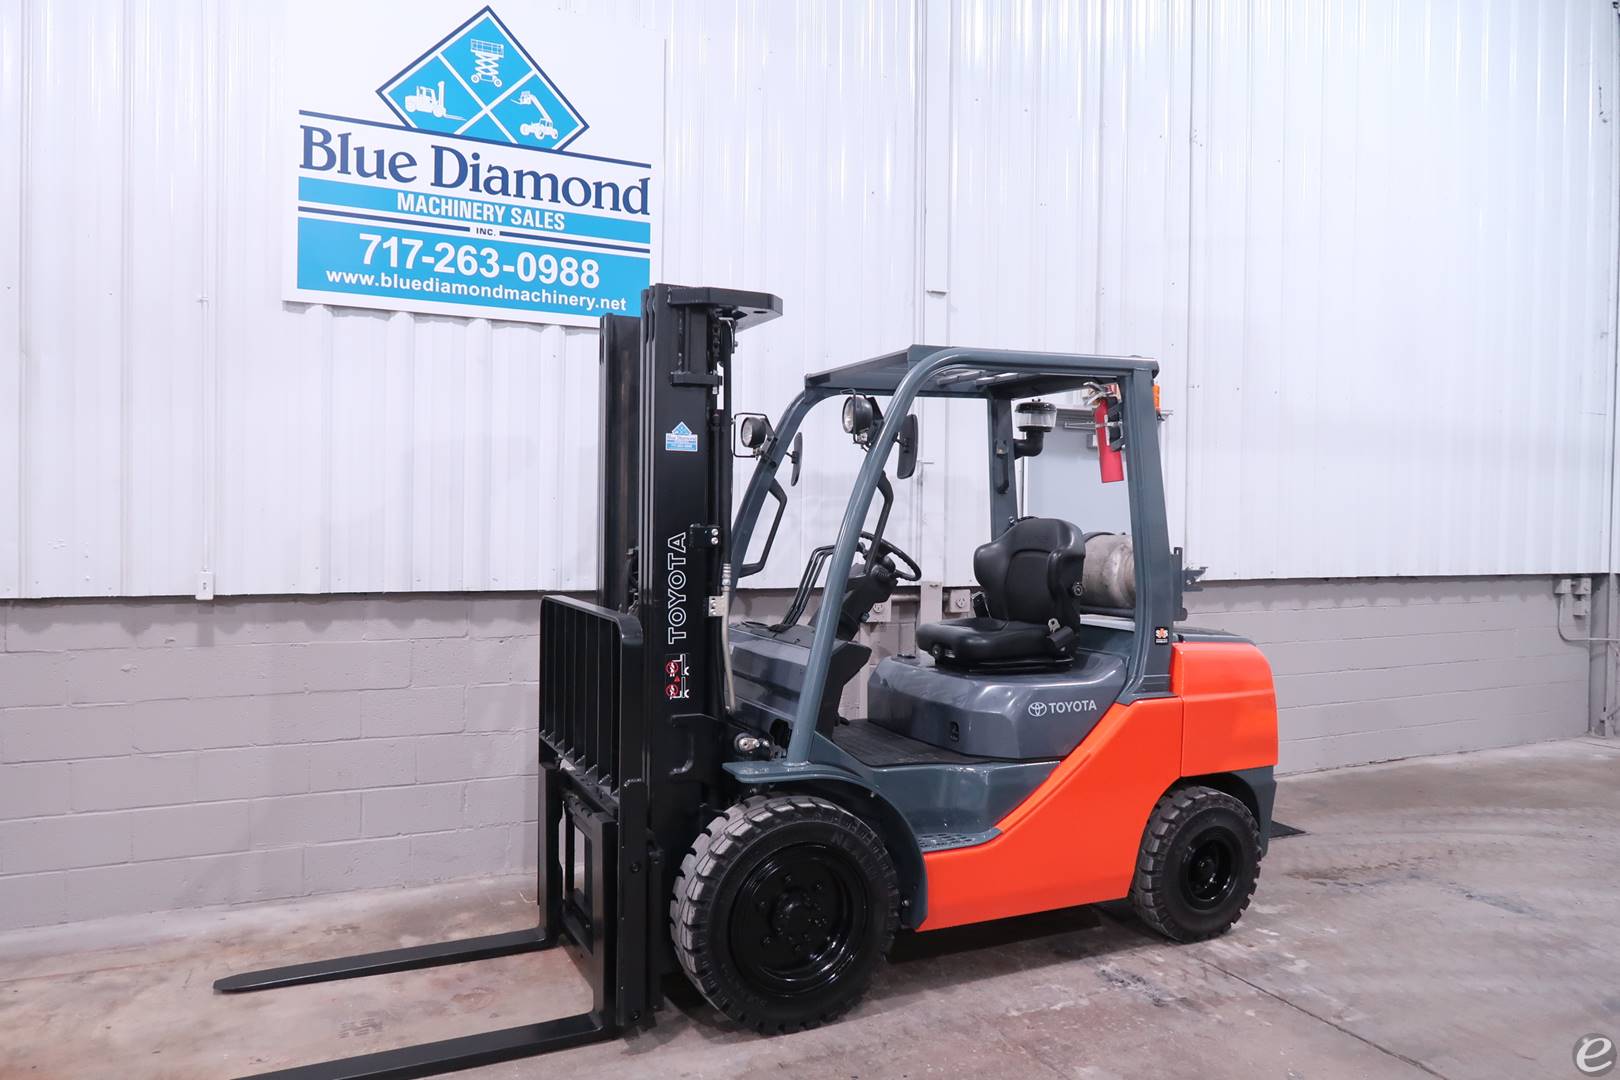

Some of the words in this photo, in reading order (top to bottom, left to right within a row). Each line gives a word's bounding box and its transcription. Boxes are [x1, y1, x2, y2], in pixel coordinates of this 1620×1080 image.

[299, 125, 417, 183] Blue
[430, 145, 650, 215] Diamond
[397, 192, 506, 223] MACHINERY
[510, 207, 565, 230] SALES
[475, 227, 496, 237] INC.
[359, 233, 600, 289] 717-263-0988
[326, 270, 627, 311] www.bluediamondmachinery.net
[668, 531, 687, 644] TOYOTA
[1049, 700, 1097, 714] TOYOTA
